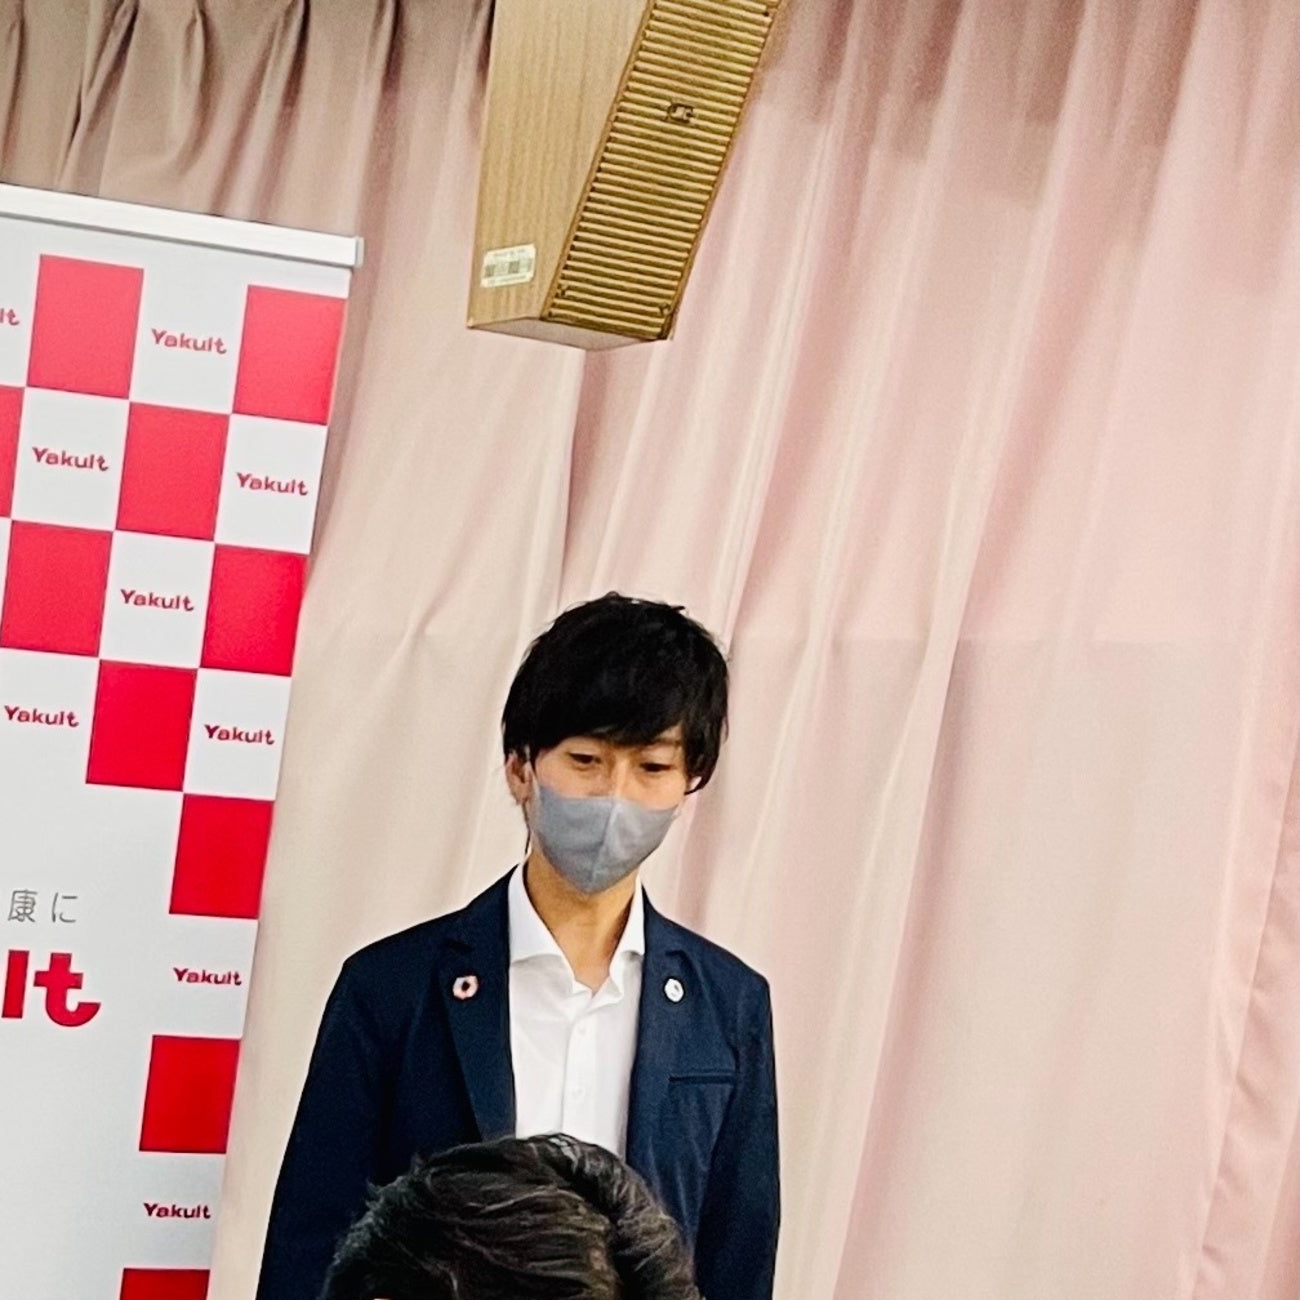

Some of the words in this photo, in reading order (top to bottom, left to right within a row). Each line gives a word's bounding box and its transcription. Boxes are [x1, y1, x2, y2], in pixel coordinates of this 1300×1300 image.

[152, 330, 226, 354] Yakult
[32, 447, 109, 471] Yakult
[236, 472, 308, 496] Yakult
[120, 589, 194, 612] Yakult
[4, 705, 79, 728] Yakult
[204, 724, 274, 745] Yakult
[173, 967, 242, 986] Yakult
[143, 1203, 211, 1219] Yakult
